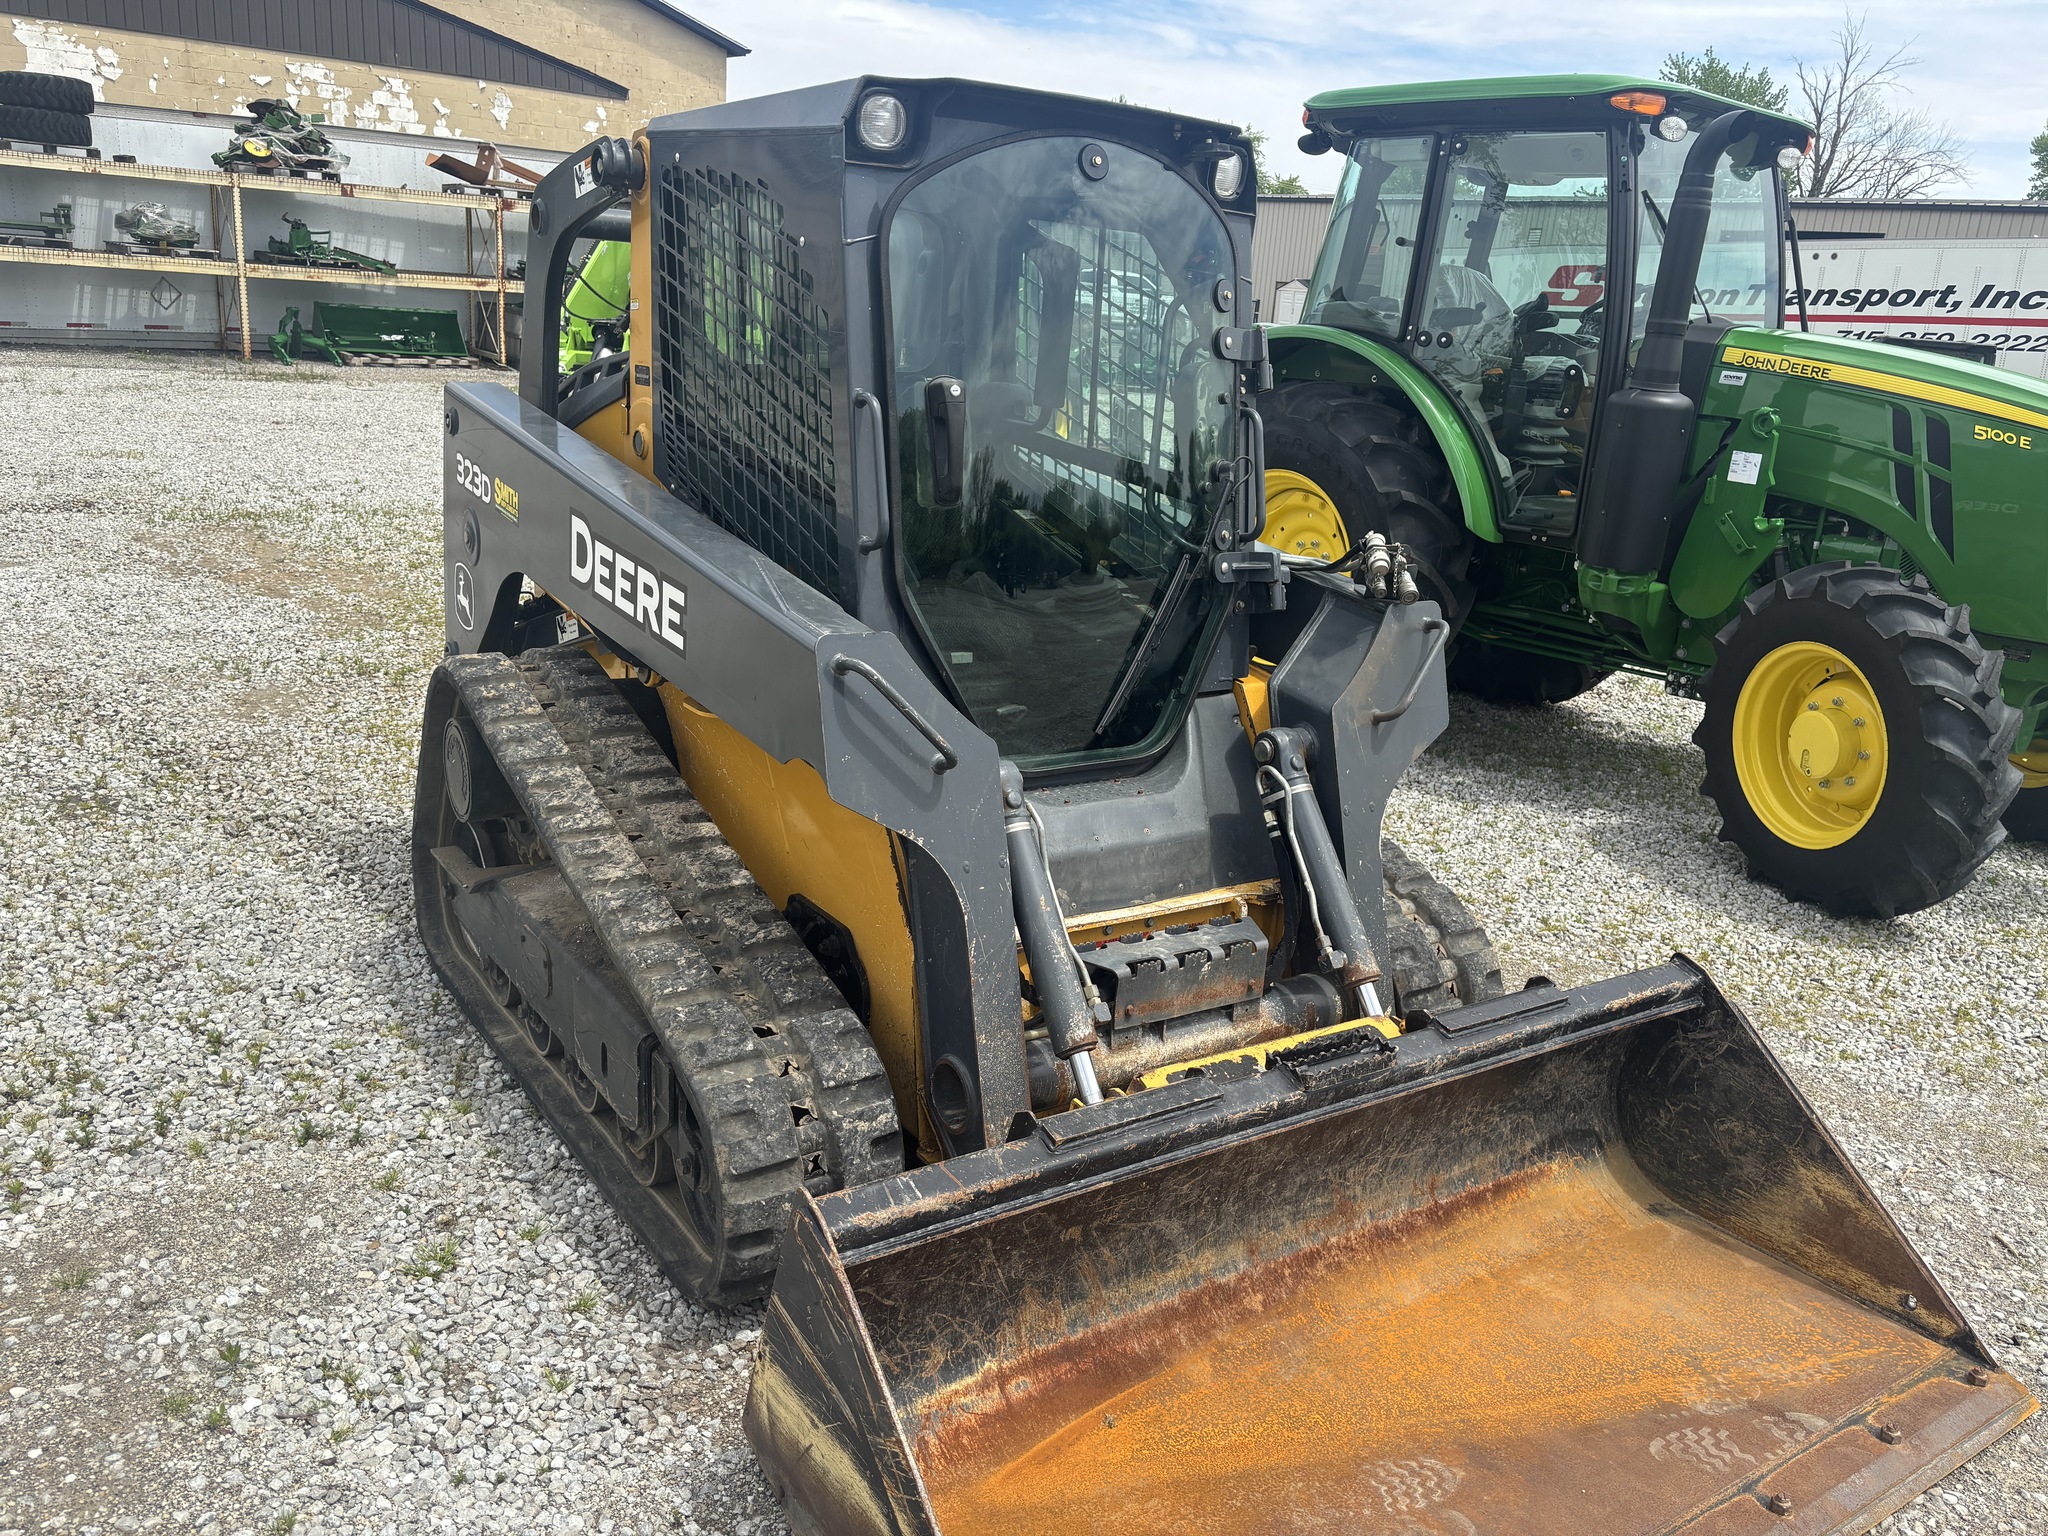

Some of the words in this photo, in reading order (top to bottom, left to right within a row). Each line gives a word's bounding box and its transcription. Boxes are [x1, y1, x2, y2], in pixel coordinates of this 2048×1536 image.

[1736, 352, 1777, 371] JOHN
[1779, 358, 1832, 379] DEERE
[1973, 424, 2017, 445] 5100
[456, 452, 491, 504] 323D
[494, 477, 519, 510] SMITH
[571, 514, 685, 651] DEERE
